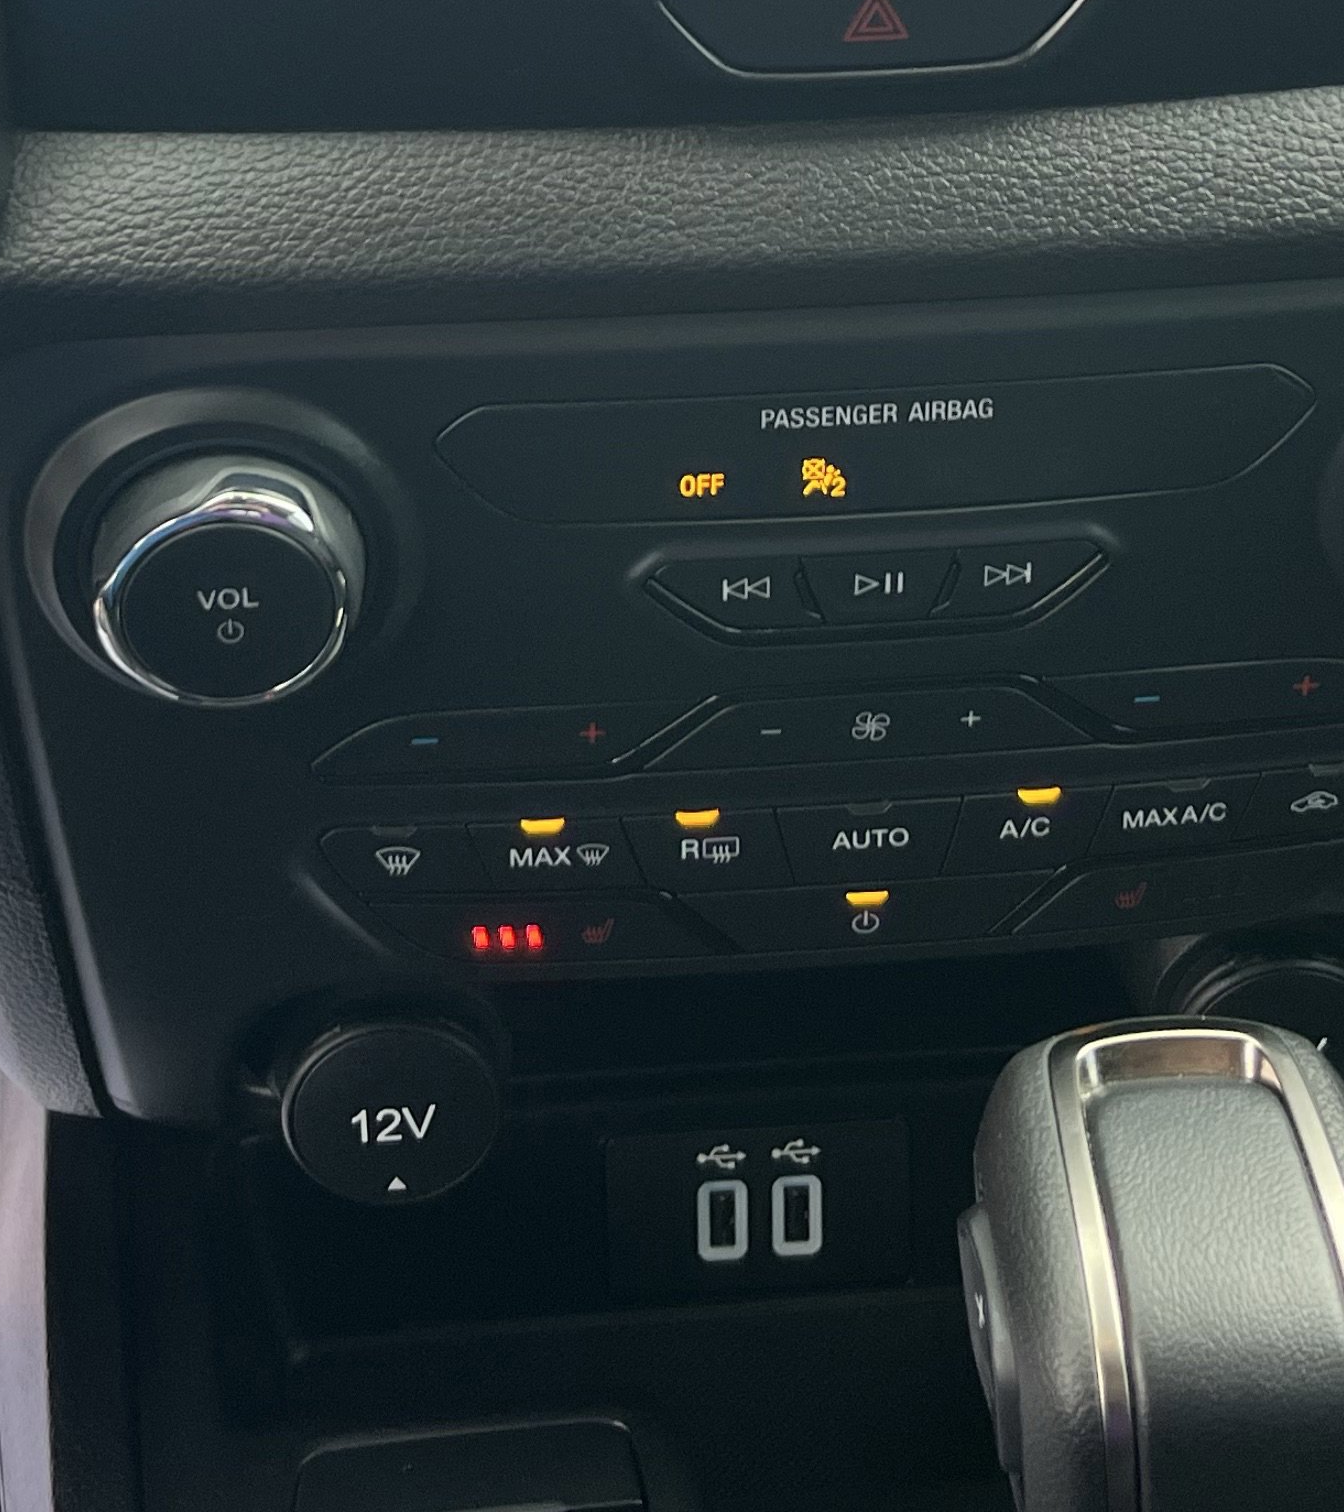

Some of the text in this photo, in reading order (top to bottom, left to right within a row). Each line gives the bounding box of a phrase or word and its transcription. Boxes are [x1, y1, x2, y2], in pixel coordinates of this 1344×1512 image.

[759, 397, 995, 431] PASSENGER AIRBAG
[678, 472, 726, 498] OFF
[196, 586, 260, 612] VOL
[832, 826, 911, 852] AUTO
[998, 816, 1052, 840] A/C
[508, 844, 573, 870] MAX
[349, 1102, 437, 1146] 12V
